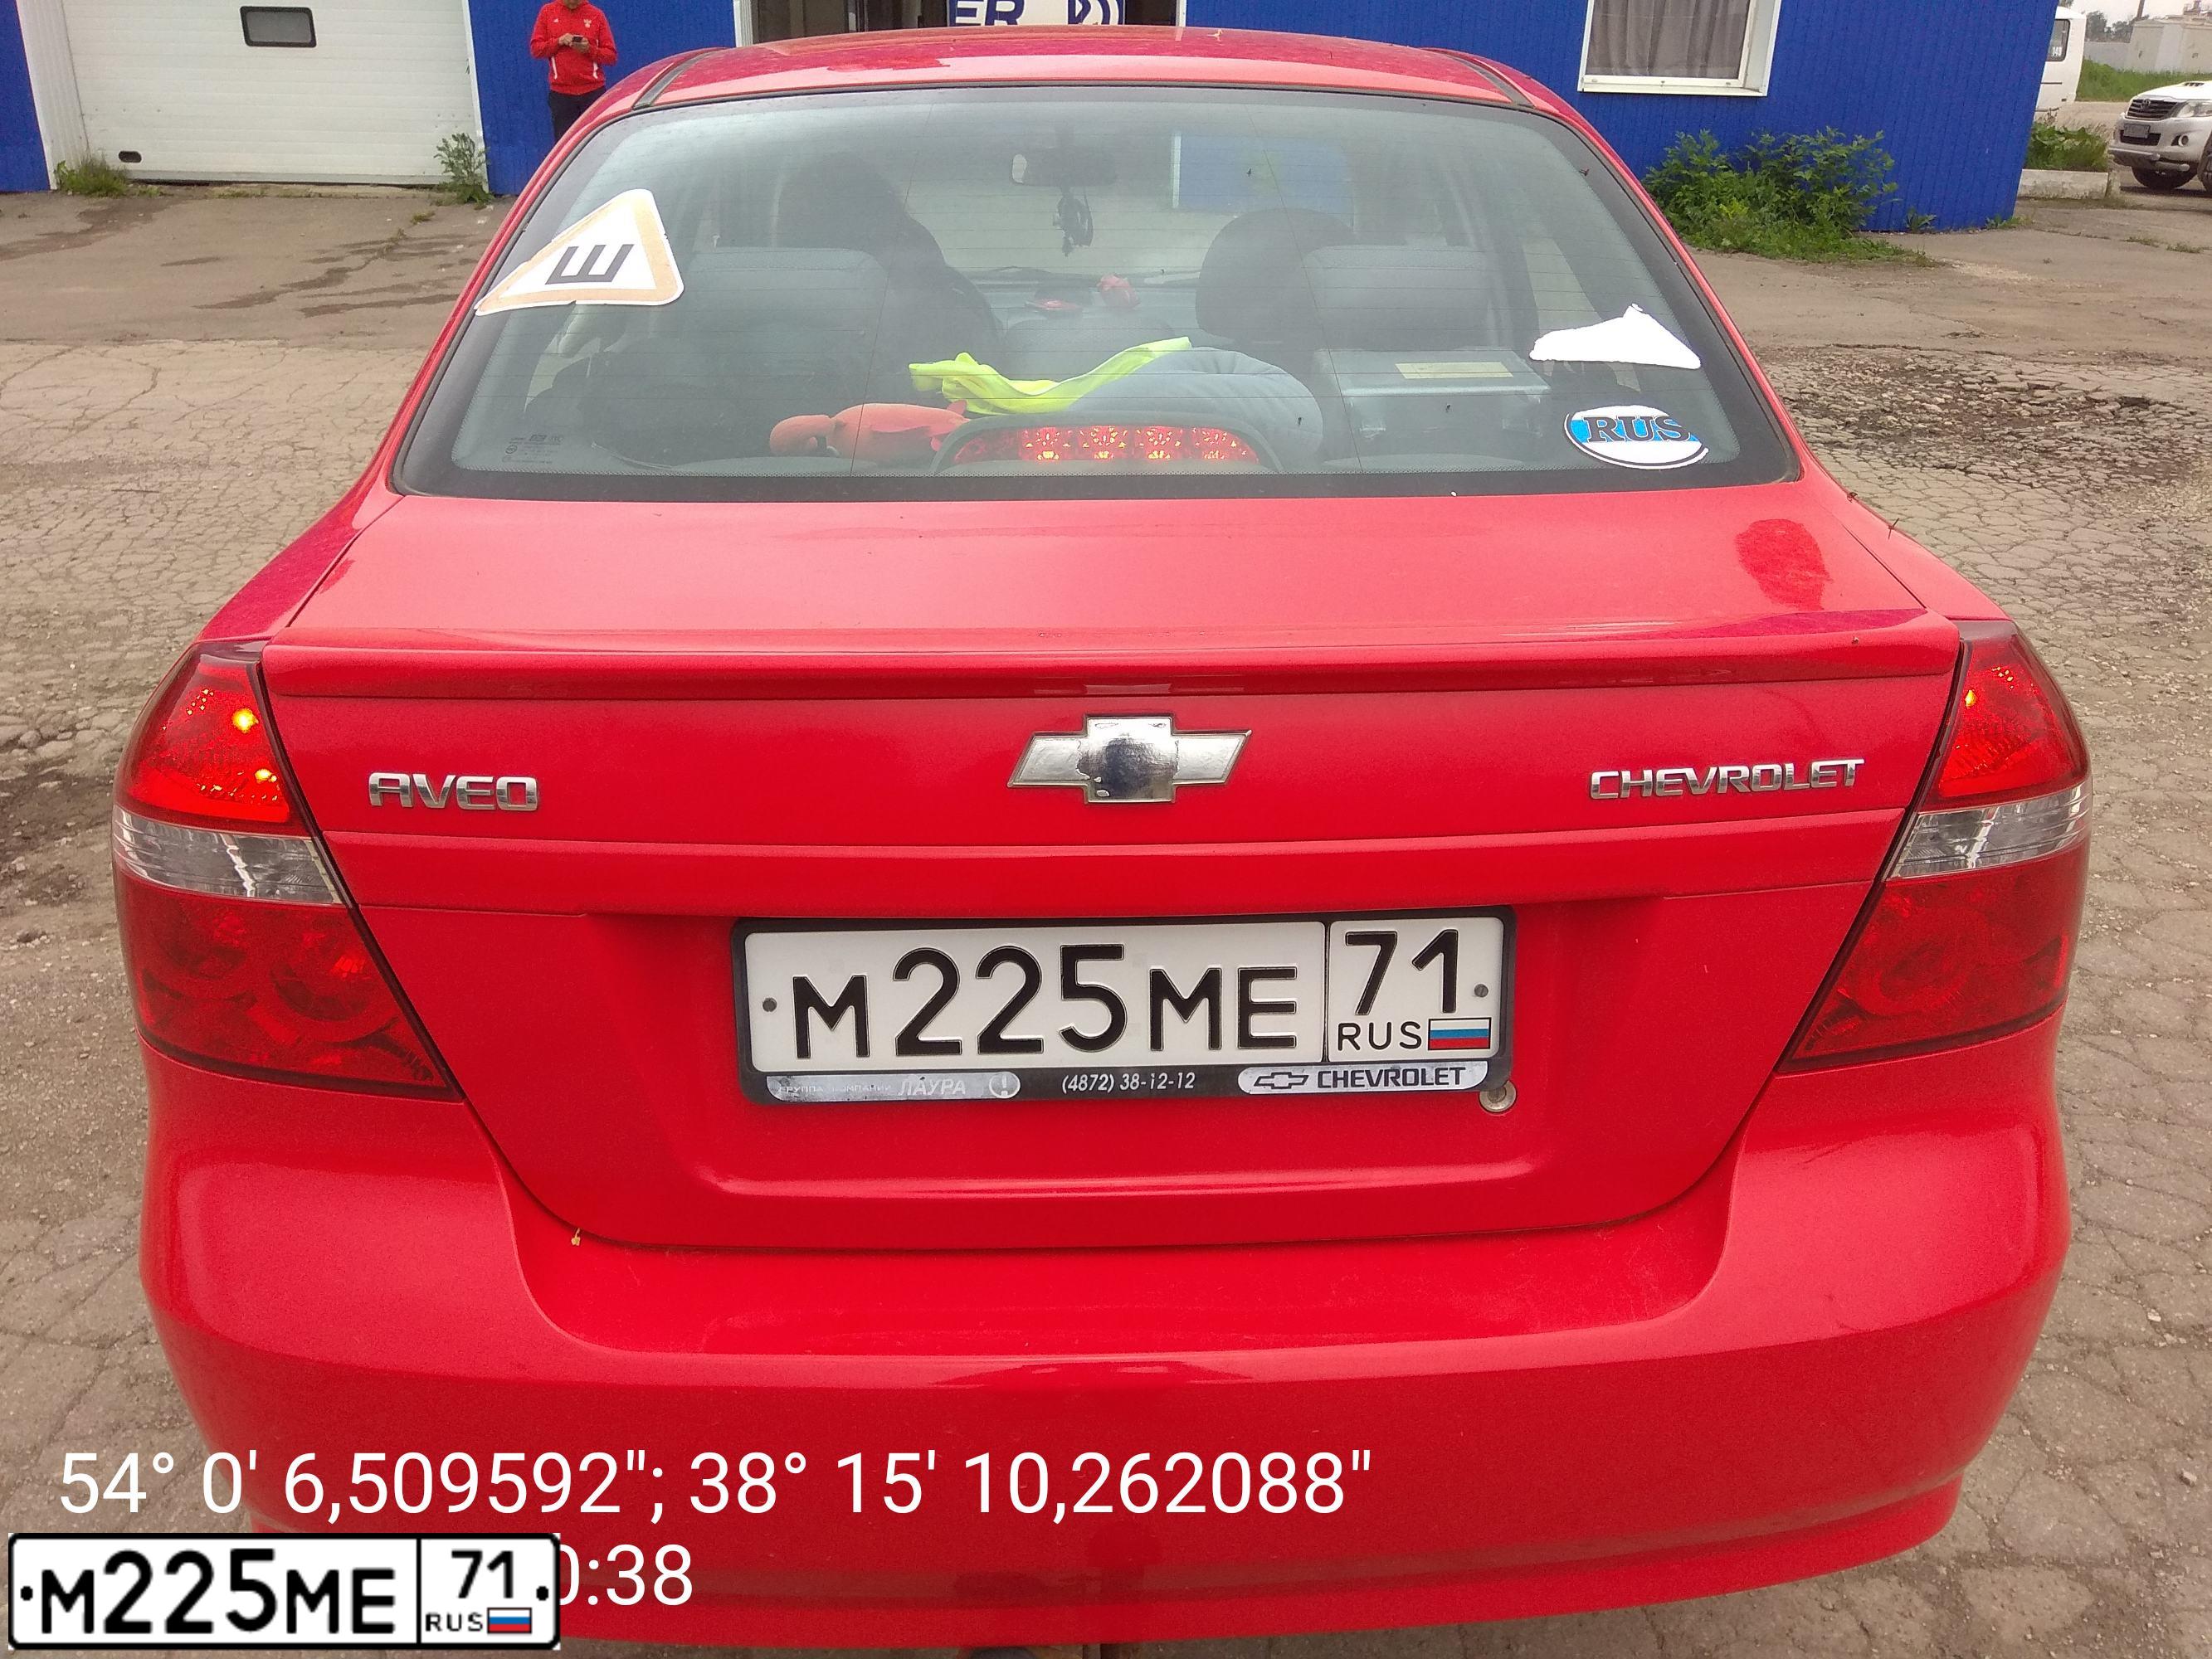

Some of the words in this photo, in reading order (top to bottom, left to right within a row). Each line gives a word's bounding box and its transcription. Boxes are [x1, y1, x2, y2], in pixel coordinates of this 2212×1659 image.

[1581, 415, 1692, 443] RUS
[368, 771, 539, 812] AVEO
[1590, 758, 1865, 800] CHEVROLET
[1343, 927, 1459, 1017] 71
[1337, 1021, 1423, 1051] RUS
[897, 1078, 967, 1097] ЛАУРА
[1061, 1073, 1115, 1094] (4872)
[1119, 1072, 1196, 1091] 38-12-12
[1317, 1066, 1467, 1089] CHEVROLET
